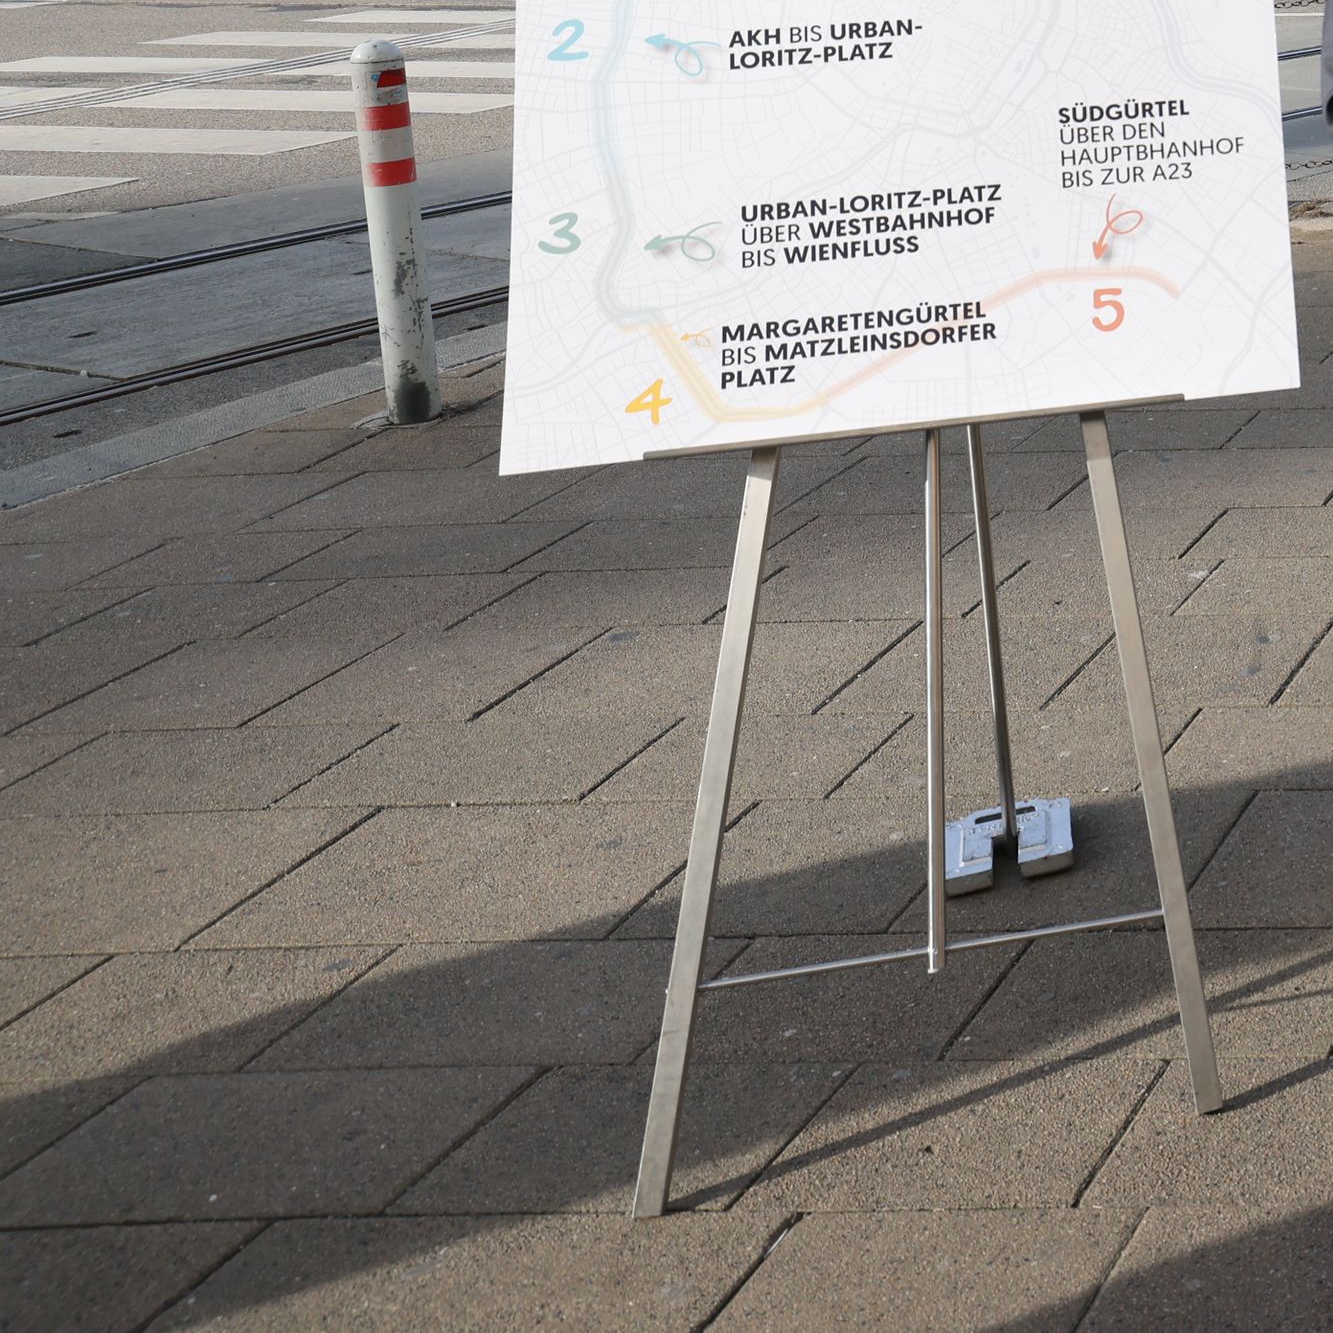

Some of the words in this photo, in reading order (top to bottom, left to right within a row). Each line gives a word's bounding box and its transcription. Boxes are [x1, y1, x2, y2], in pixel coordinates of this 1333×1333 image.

[547, 19, 590, 61] 2
[729, 28, 781, 48] AKH
[789, 26, 823, 44] BIS
[830, 19, 923, 41] URBAN-
[729, 42, 893, 70] LORITZ-PLATZ
[1058, 99, 1190, 124] SÜDGÜRTEL
[1060, 124, 1115, 145] ÜBER
[1122, 122, 1165, 141] DEN
[1061, 137, 1245, 167] HAUPTBHANHOF
[1062, 169, 1094, 189] BIS
[1101, 165, 1145, 186] ZUR
[1152, 162, 1193, 182] A23
[741, 184, 1002, 223] URBAN-LORITZ-PLATZ
[538, 212, 581, 254] 3
[741, 223, 801, 246] ÜBER
[808, 206, 995, 240] WESTBAHNHOF
[741, 248, 776, 269] BIS
[783, 236, 919, 265] WIENFLUSS
[721, 301, 986, 344] MARGARETENGÜRTEL
[1092, 288, 1125, 332] 5
[721, 346, 756, 367] BIS
[764, 323, 997, 363] MATZLEINSDORFER
[720, 365, 796, 390] PLATZ
[624, 378, 672, 425] 4
